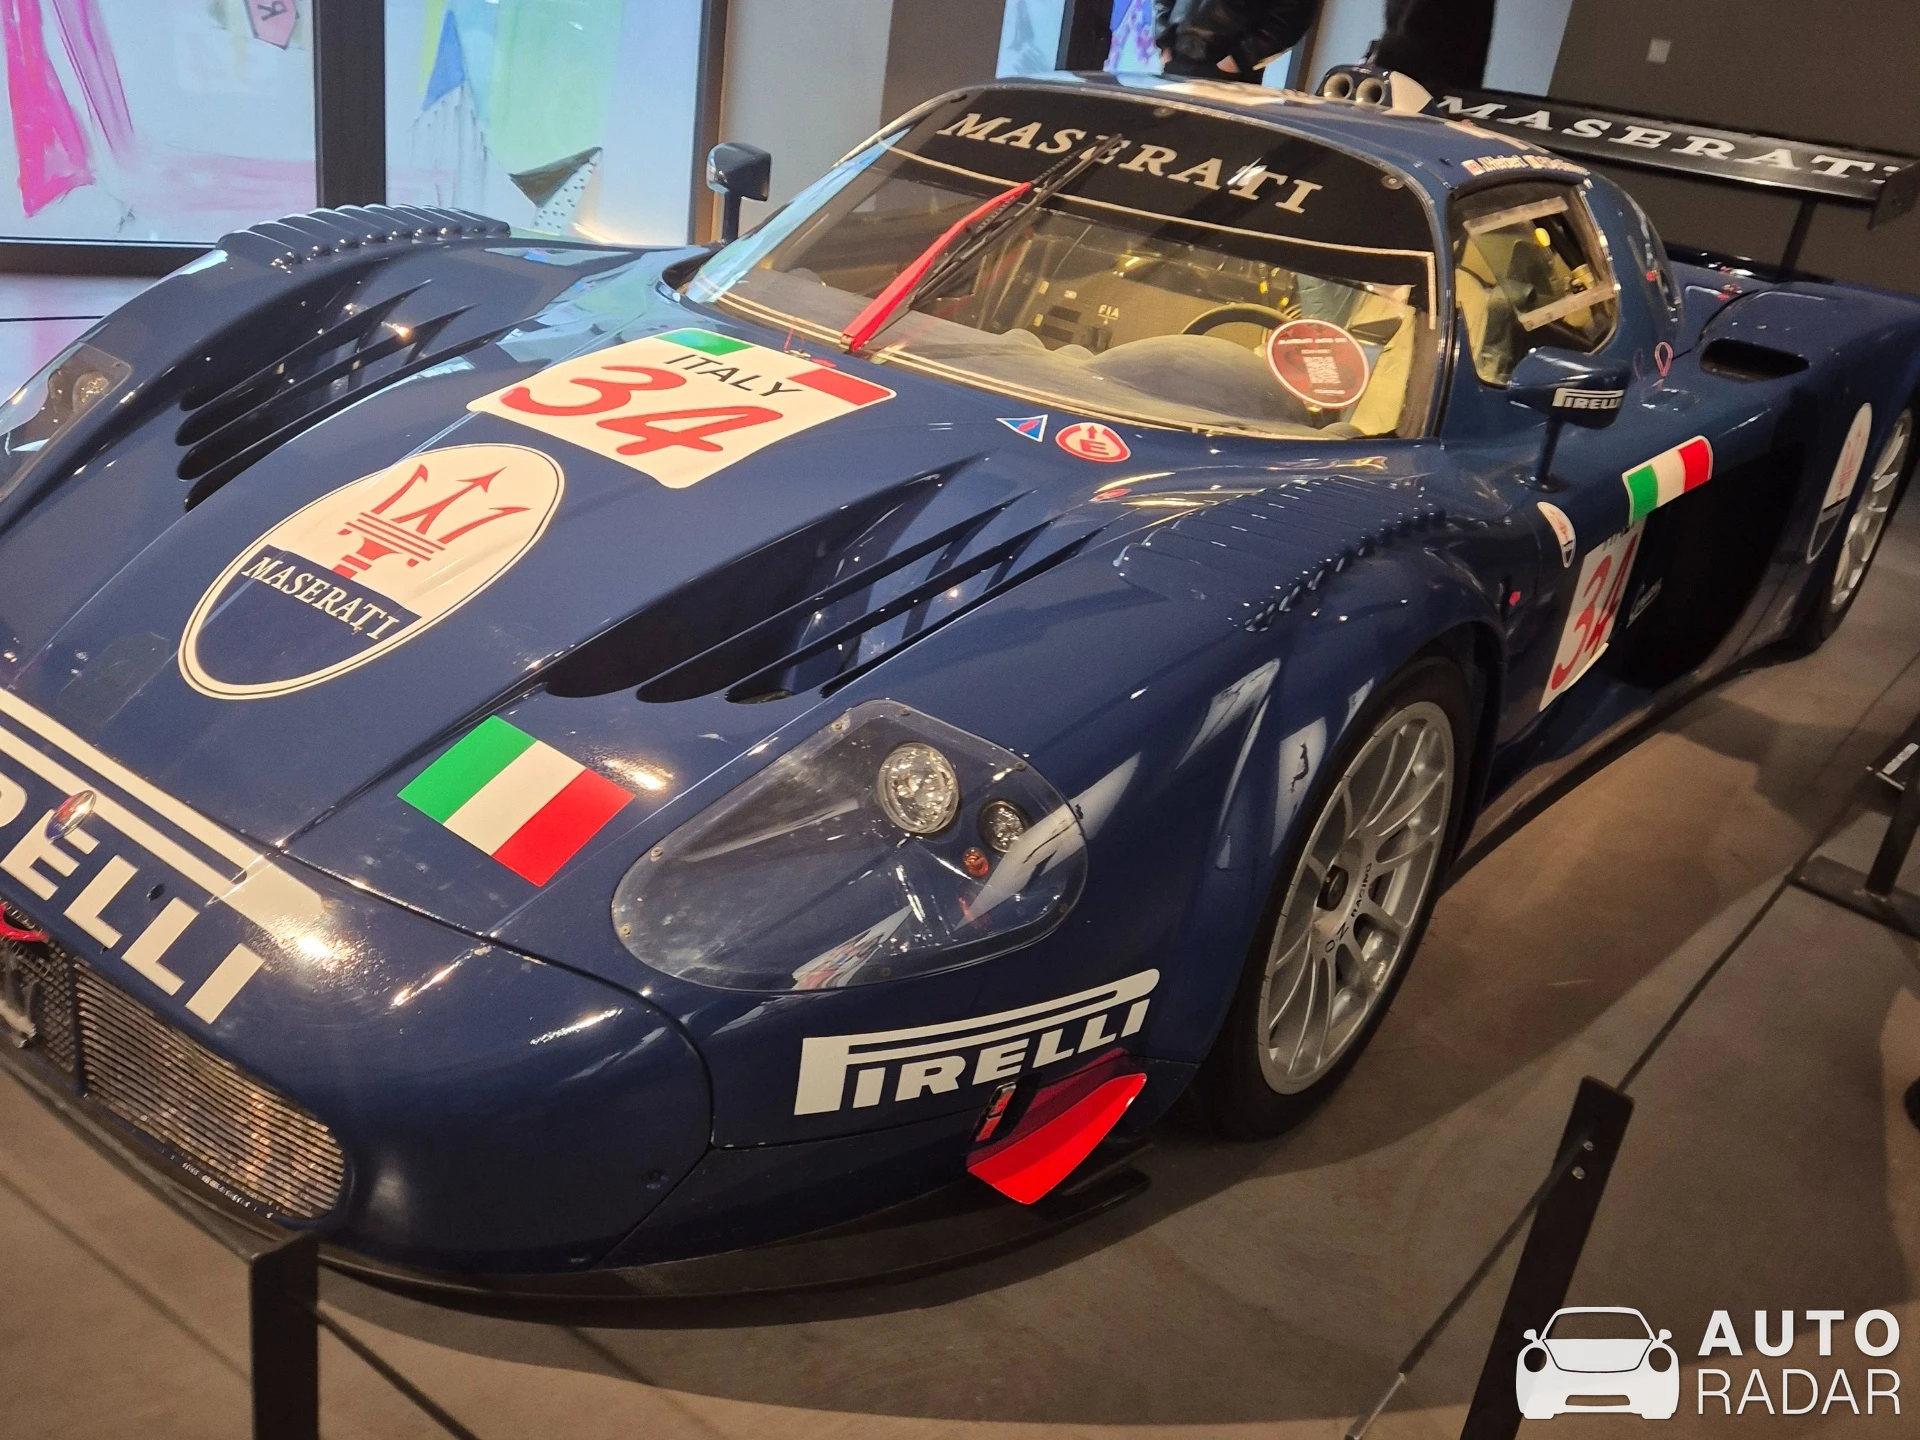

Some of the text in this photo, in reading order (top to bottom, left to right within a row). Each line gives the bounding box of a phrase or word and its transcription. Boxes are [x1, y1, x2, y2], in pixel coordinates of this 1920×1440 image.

[936, 113, 1324, 214] MASERATI
[500, 365, 784, 456] 34
[664, 353, 805, 397] ITALY
[240, 556, 400, 640] MASERATI
[1551, 533, 1639, 691] 34
[794, 968, 1161, 1116] PIRELLI
